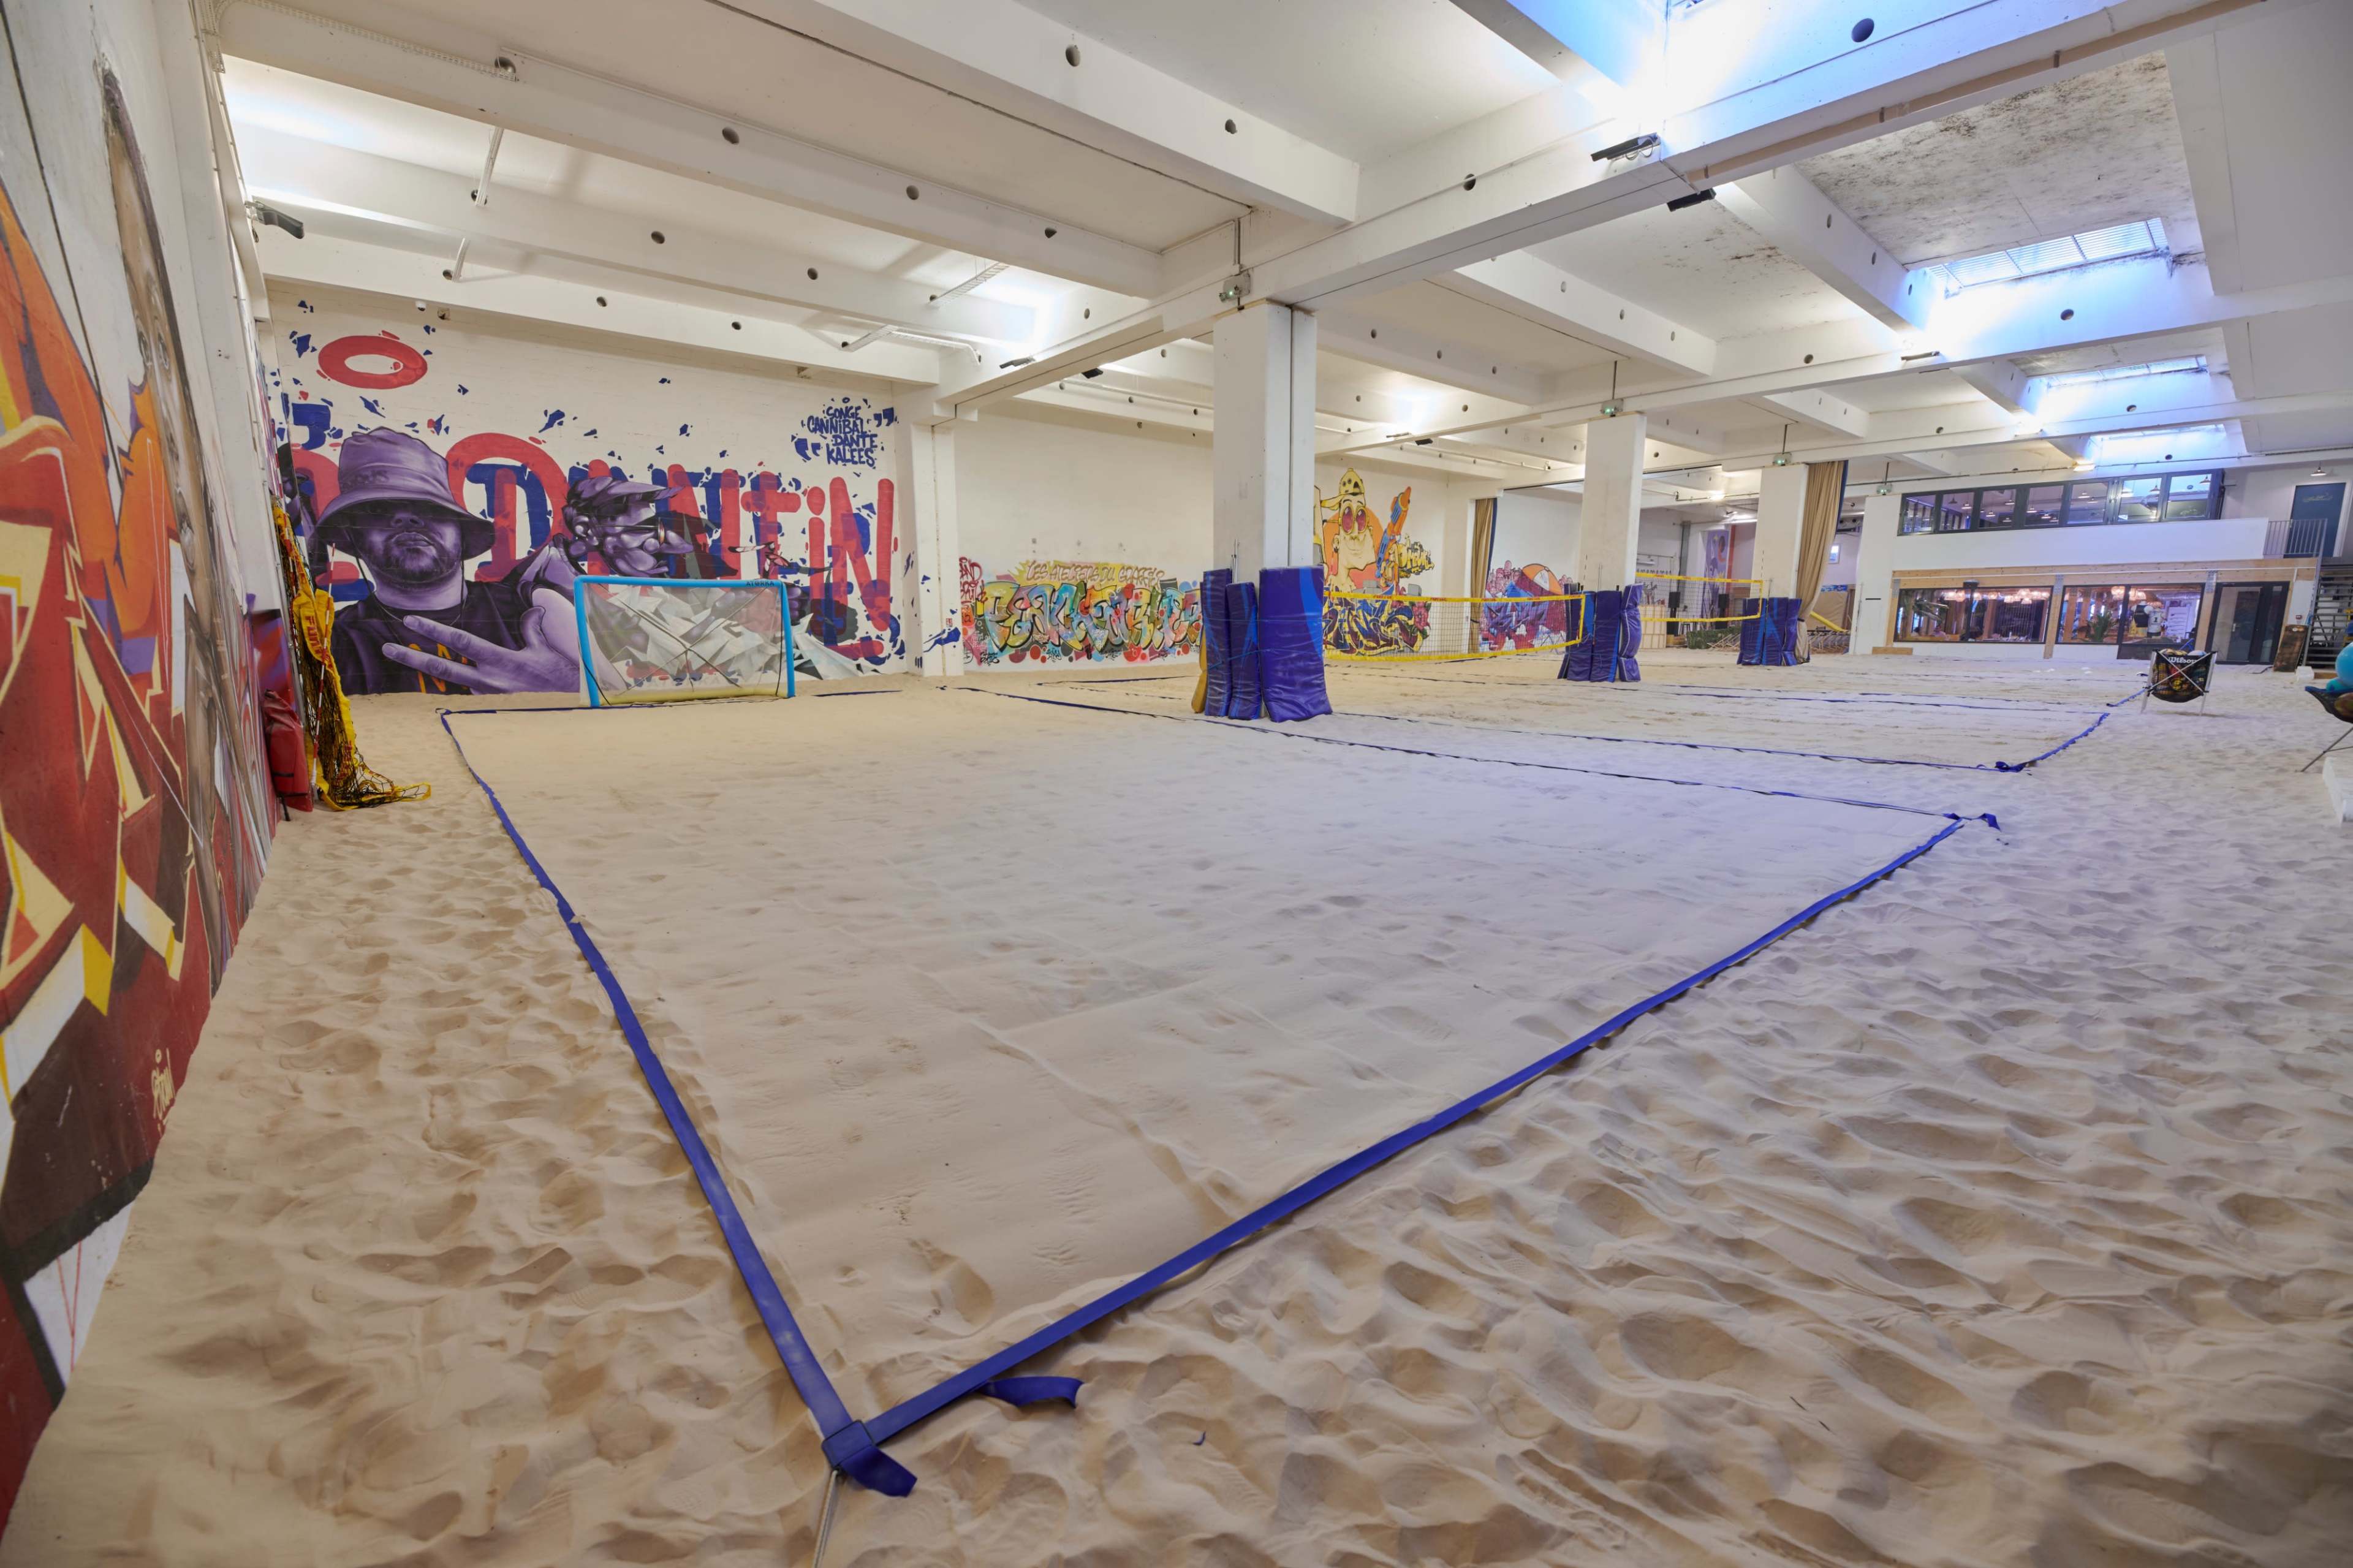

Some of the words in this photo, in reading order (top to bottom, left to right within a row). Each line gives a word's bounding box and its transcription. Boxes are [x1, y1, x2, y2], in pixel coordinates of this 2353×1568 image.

[826, 406, 862, 420] SONGE
[832, 433, 878, 449] DANTE
[825, 442, 875, 468] KALEES
